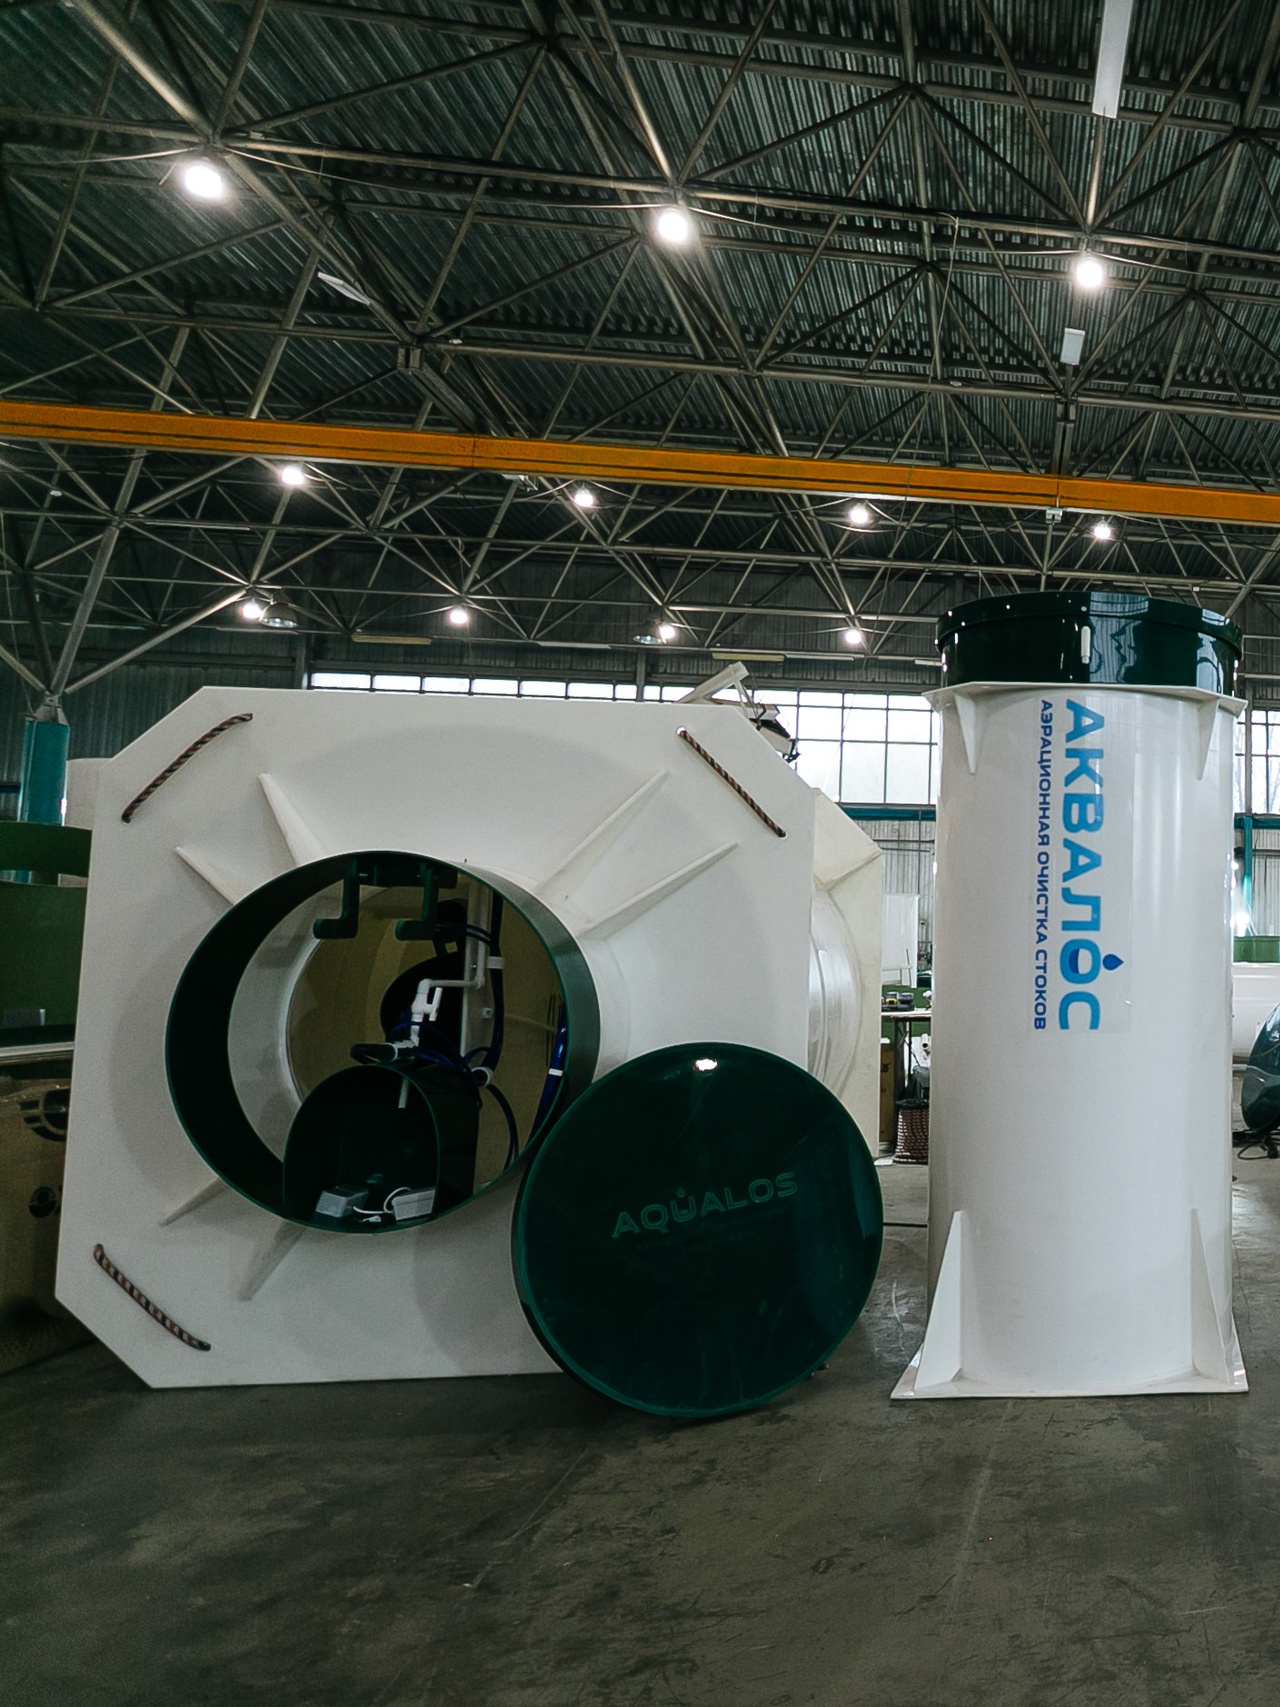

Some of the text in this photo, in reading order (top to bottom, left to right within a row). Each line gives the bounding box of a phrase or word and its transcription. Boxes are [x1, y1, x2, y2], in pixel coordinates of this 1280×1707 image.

[1034, 699, 1053, 1030] АЭРАЦИОННАЯ ОЧИСТКА СТОКОВ
[1058, 698, 1105, 1030] АКВАЛОС
[612, 1172, 798, 1238] AQUALOS
